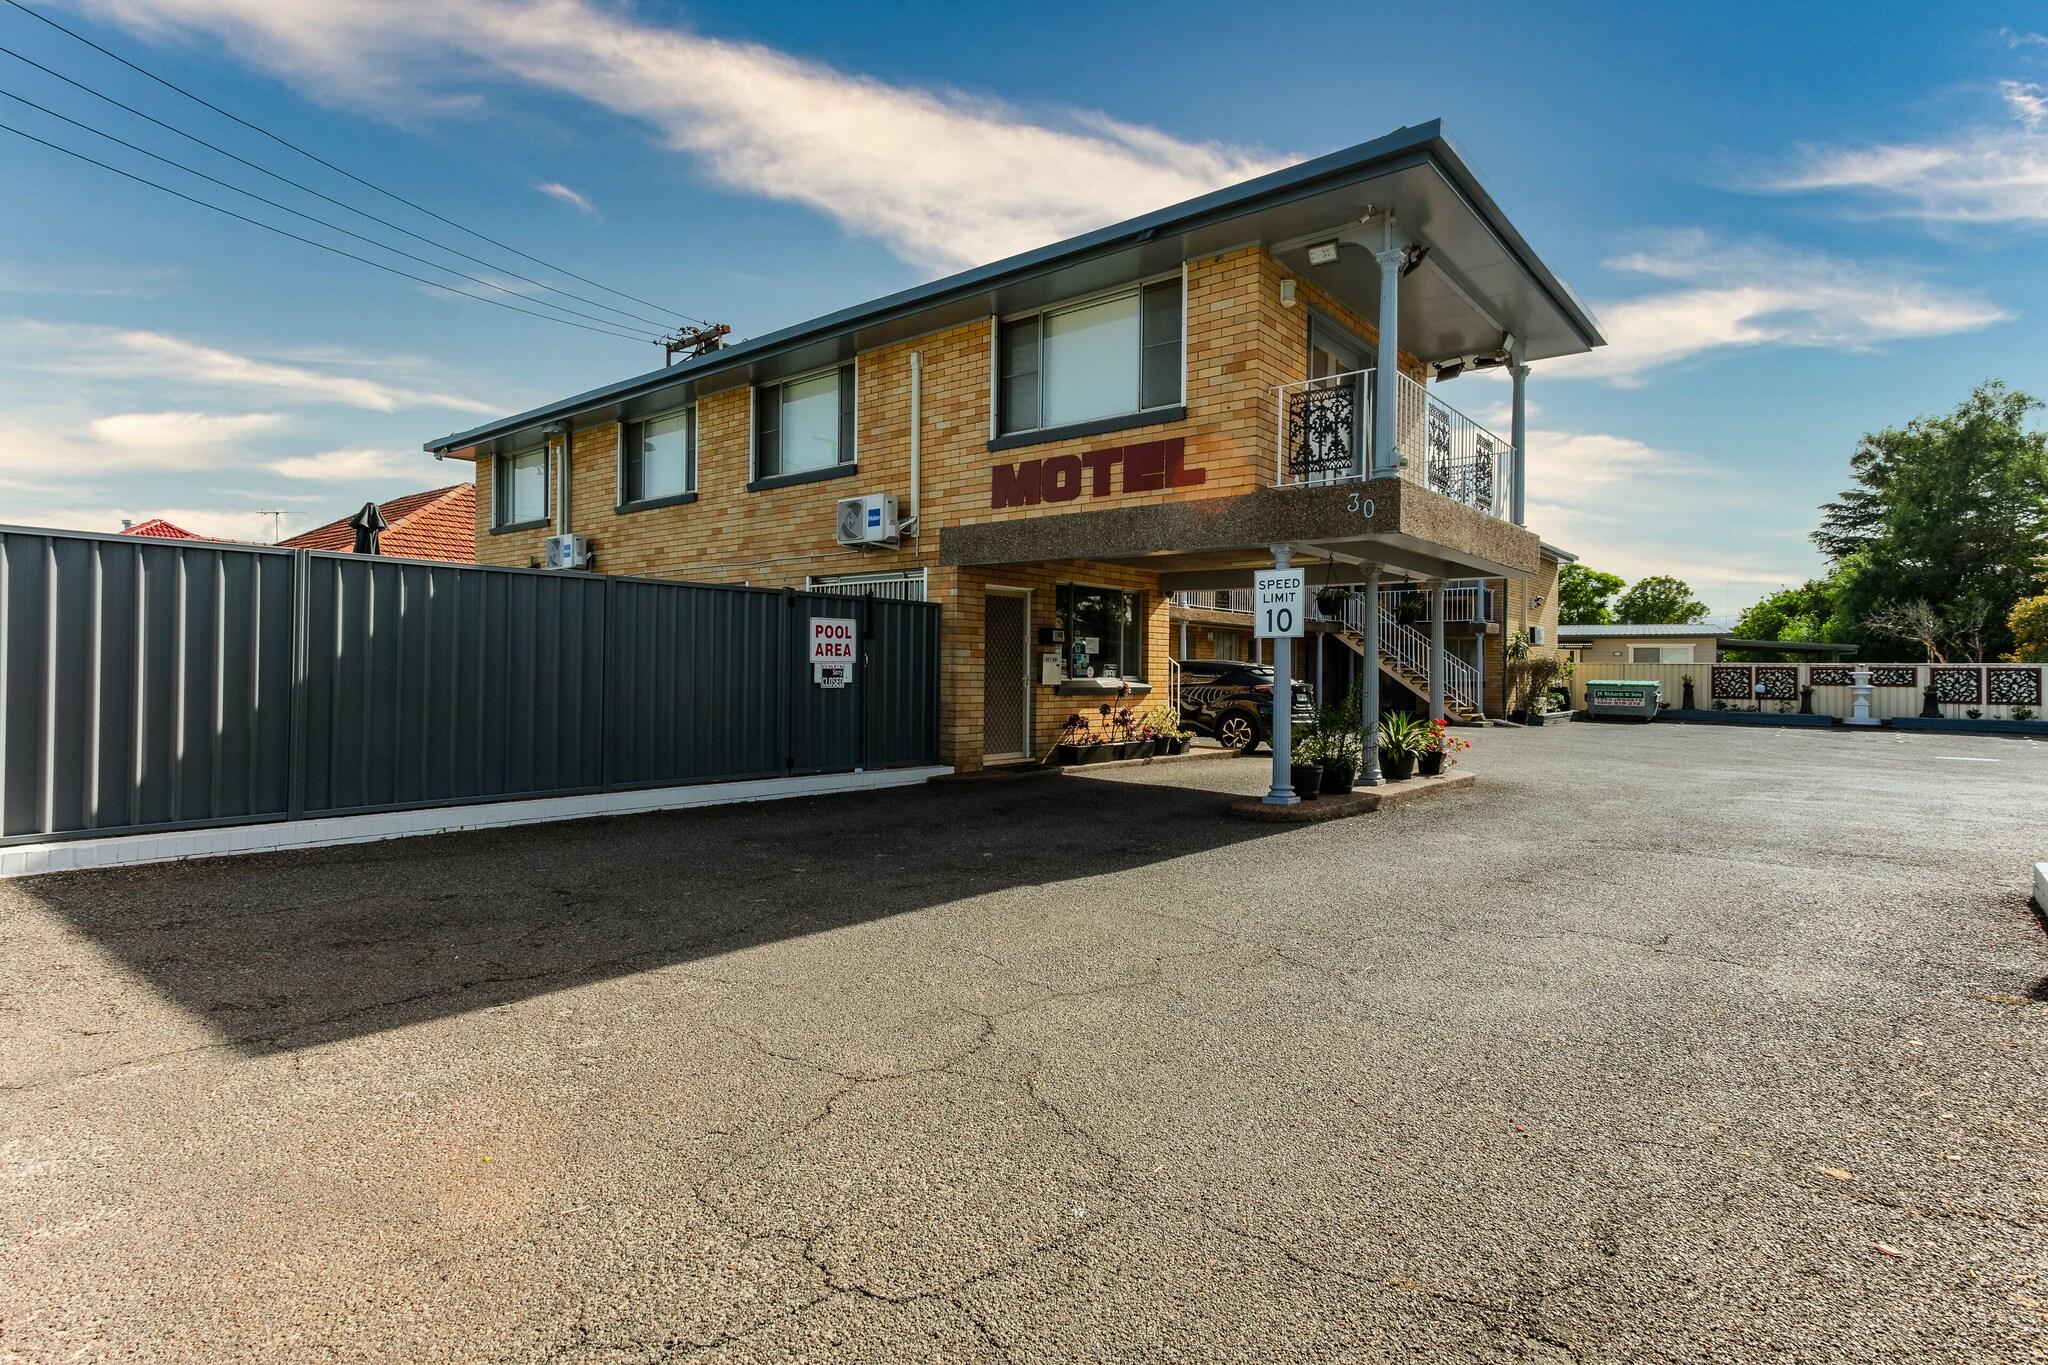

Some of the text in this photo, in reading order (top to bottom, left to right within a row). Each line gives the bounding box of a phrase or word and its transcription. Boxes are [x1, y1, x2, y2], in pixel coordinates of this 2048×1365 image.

[991, 437, 1206, 509] MOTEL
[1347, 493, 1375, 518] 30
[1258, 578, 1301, 590] SPEED
[1263, 592, 1296, 604] LIMIT
[1266, 608, 1293, 632] 10
[815, 625, 852, 639] POOL
[815, 643, 852, 656] AREA
